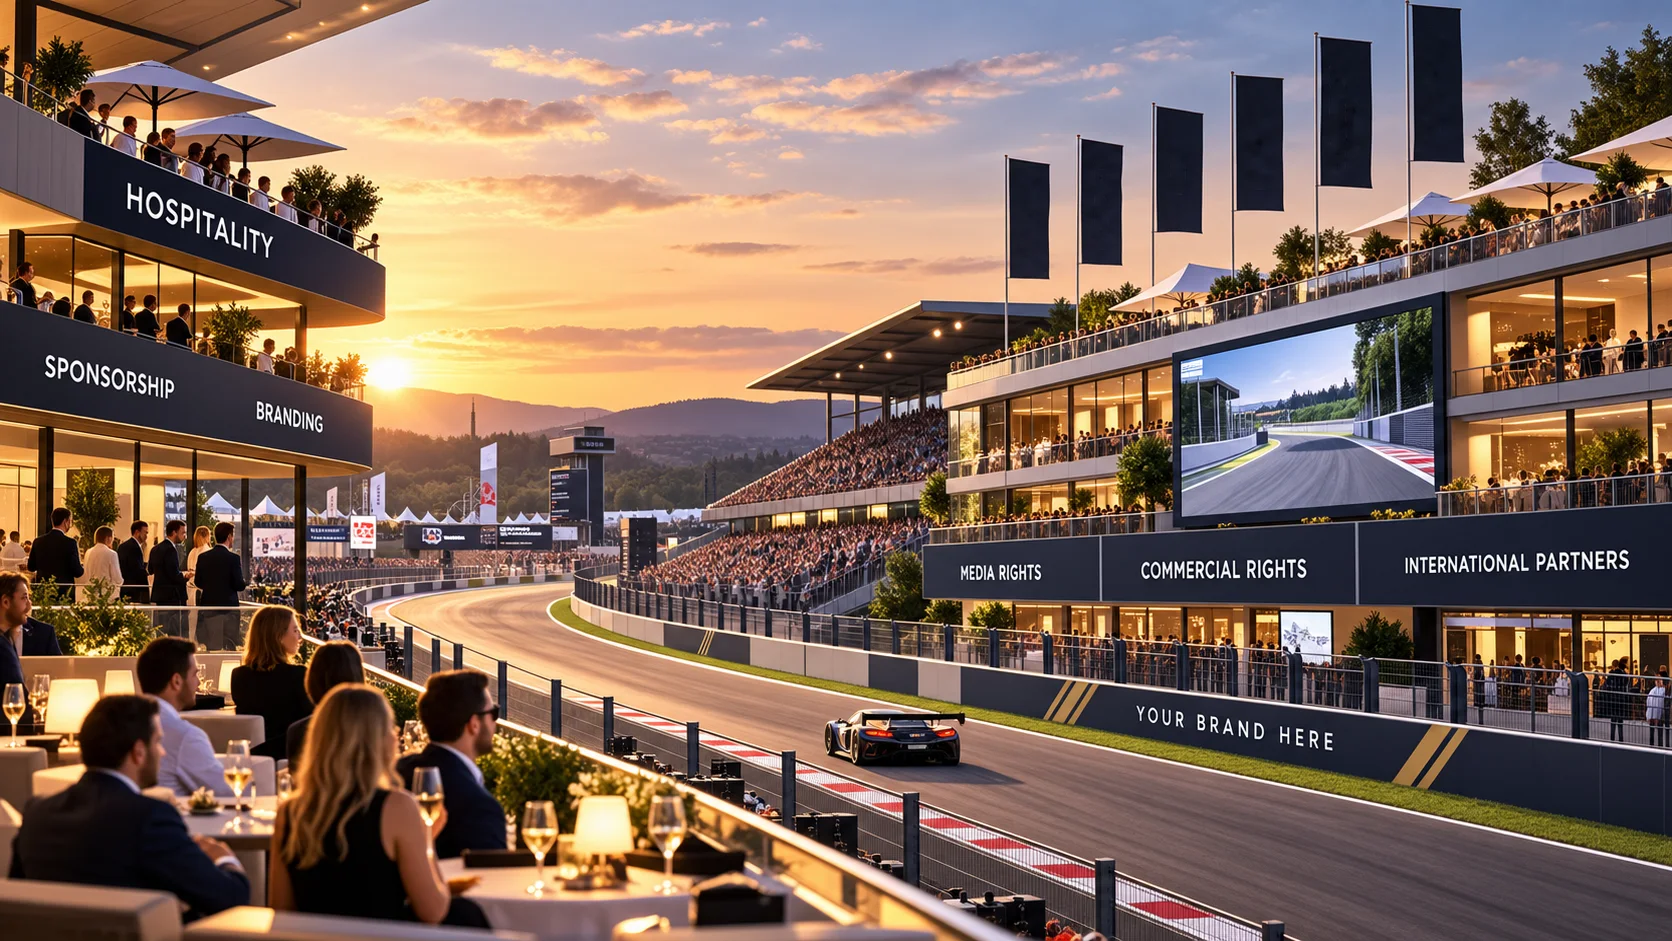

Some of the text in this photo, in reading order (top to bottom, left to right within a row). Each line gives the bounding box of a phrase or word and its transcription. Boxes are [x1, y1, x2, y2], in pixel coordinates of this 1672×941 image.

[126, 182, 274, 259] HOSPITALITY
[44, 354, 175, 400] SPONSORSHIP
[256, 401, 324, 434] BRANDING
[960, 563, 1042, 581] MEDIA RIGHTS
[1140, 557, 1308, 580] COMMERCIAL RIGHTS
[1404, 549, 1630, 575] INTERNATIONAL PARTNERS
[1136, 705, 1335, 751] YOUR BRAND HERE
